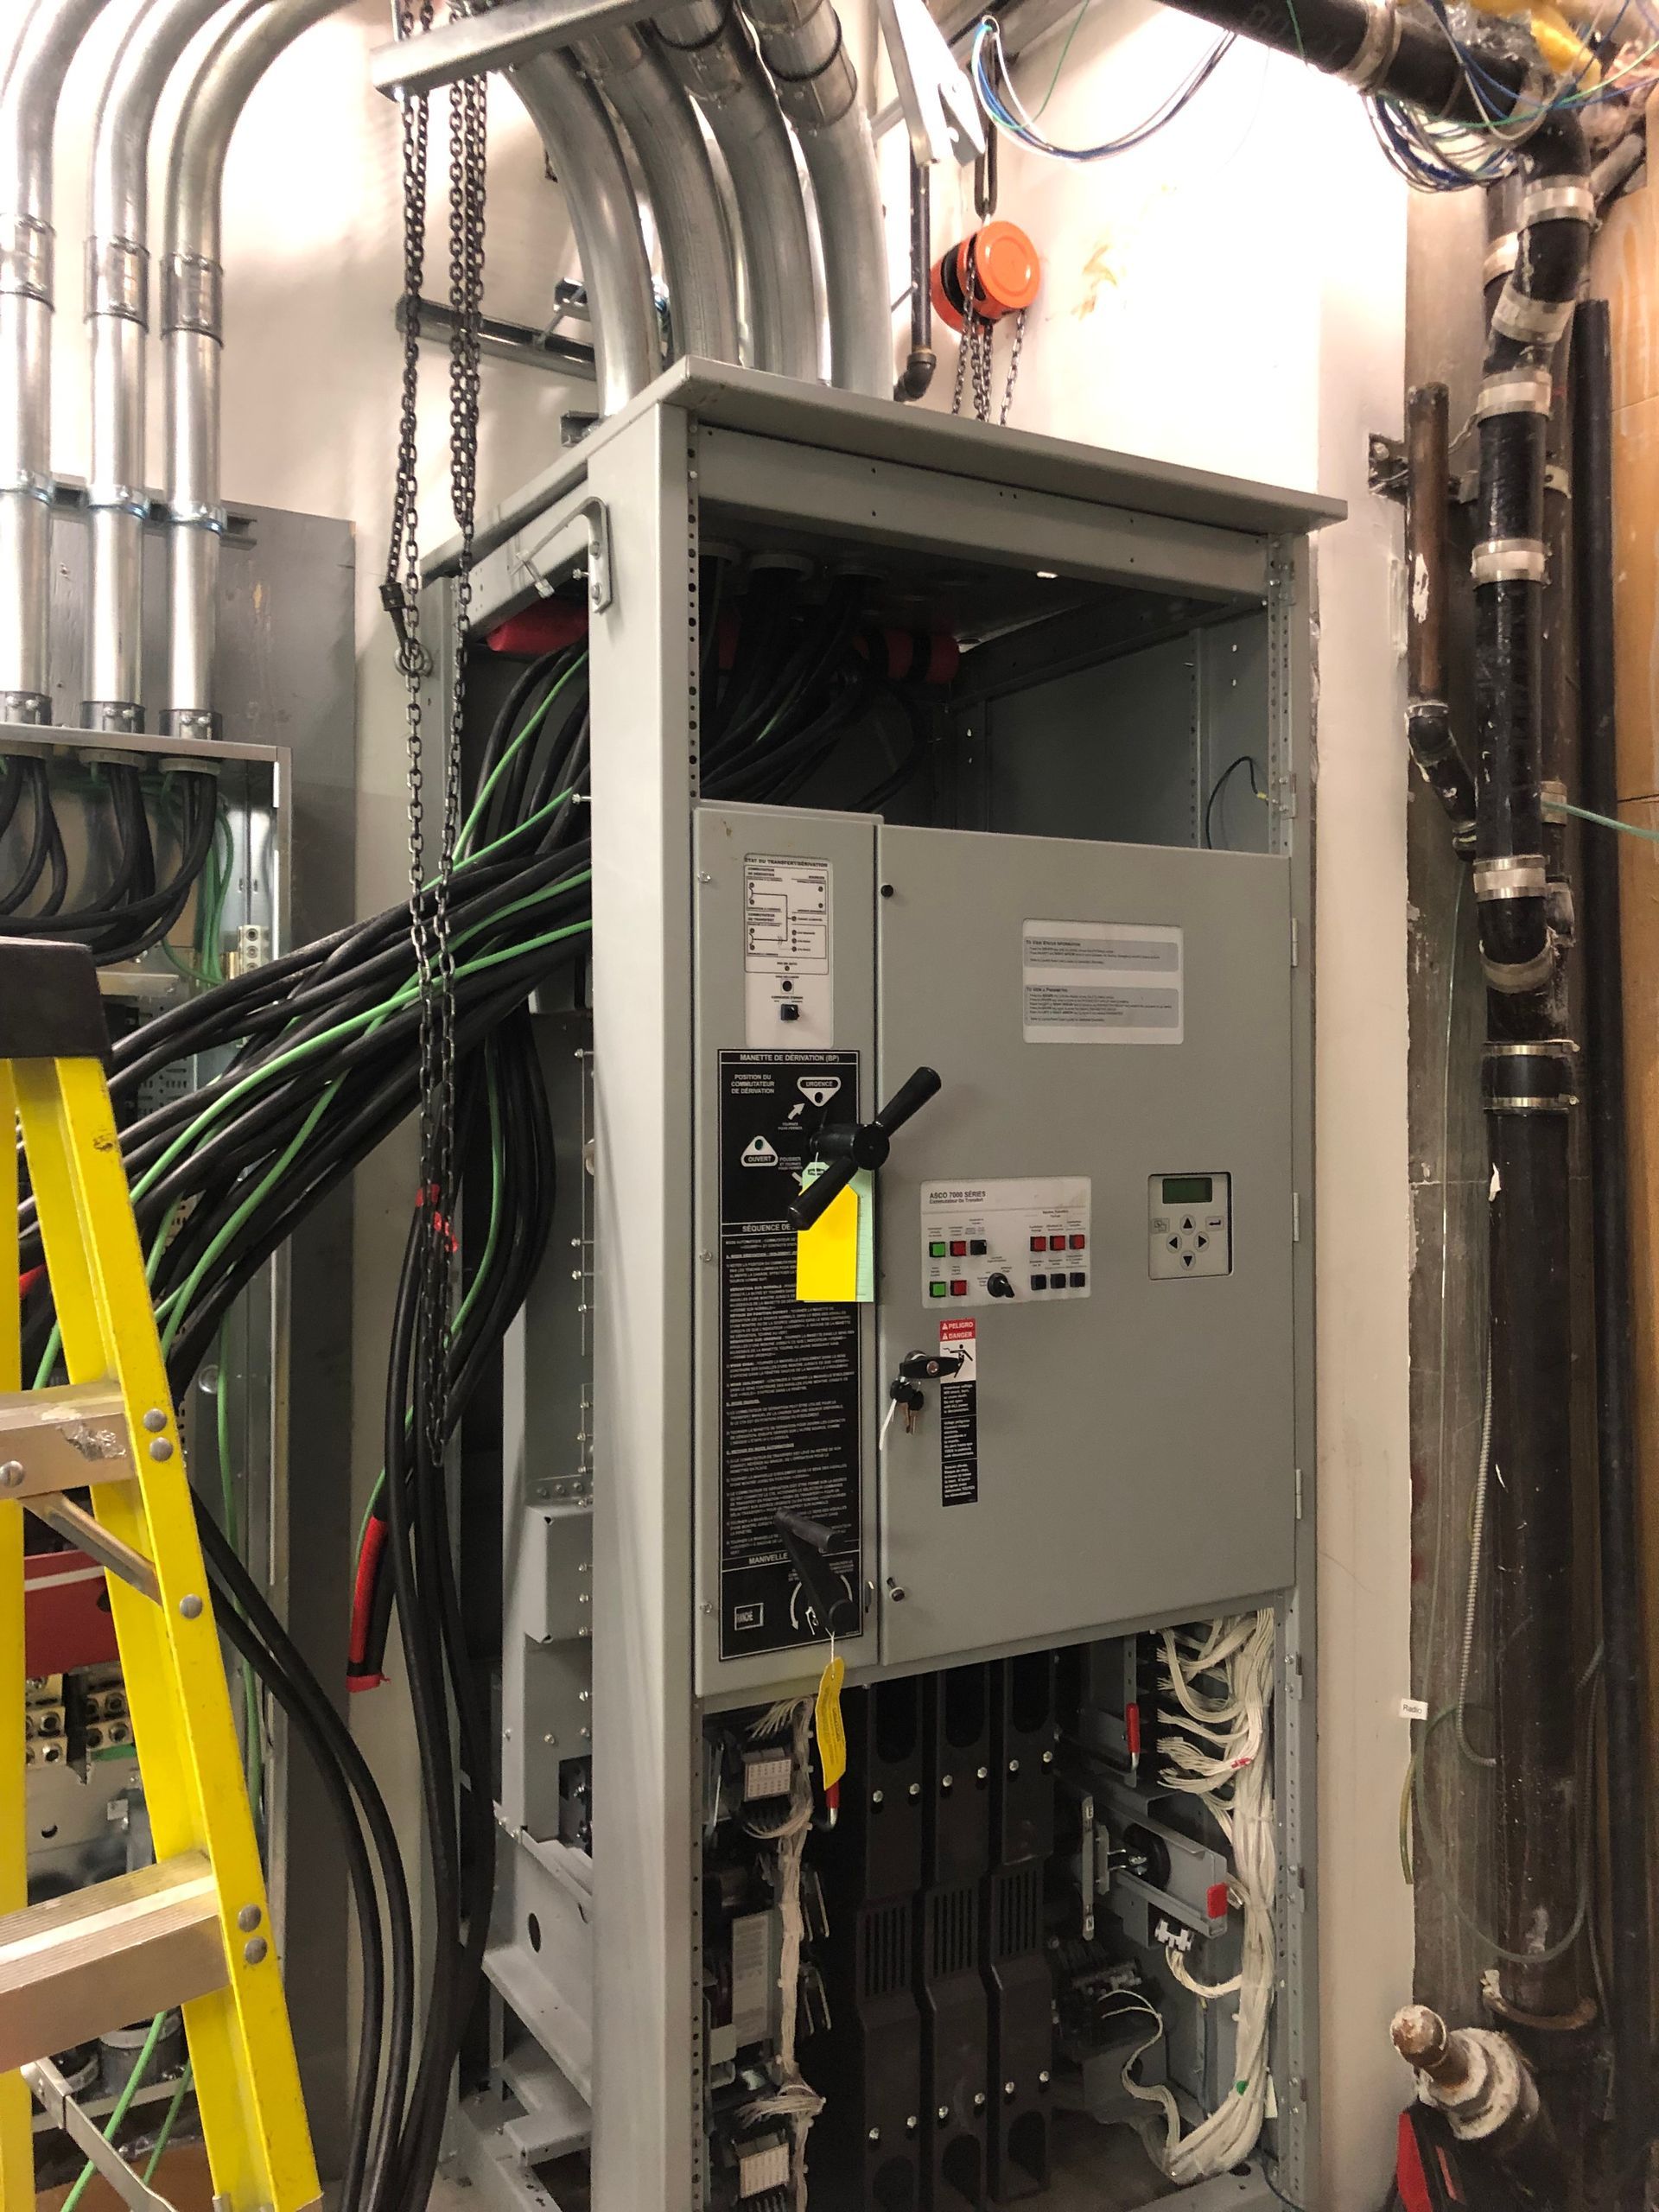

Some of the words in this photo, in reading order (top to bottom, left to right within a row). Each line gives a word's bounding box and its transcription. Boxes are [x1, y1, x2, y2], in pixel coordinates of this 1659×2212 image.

[785, 1053, 824, 1062] DÉRIVATION
[742, 1223, 780, 1232] SÉQUENCE
[748, 1553, 789, 1565] MANIVELLE
[1402, 1704, 1423, 1714] Radio
